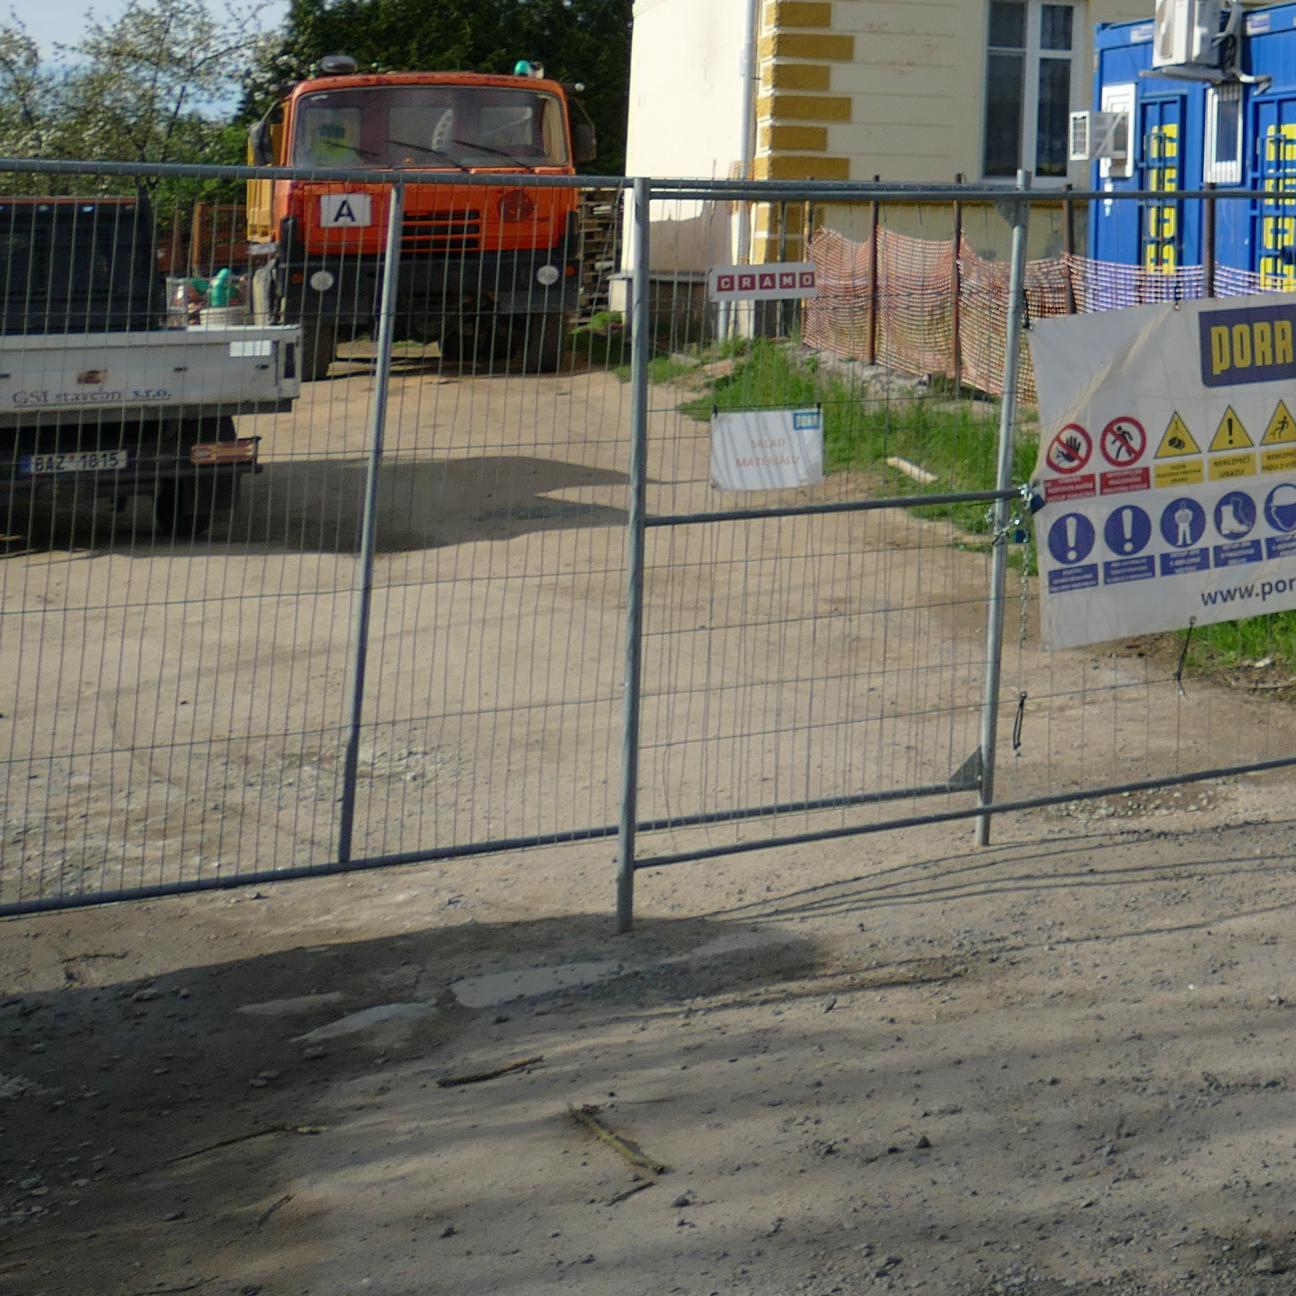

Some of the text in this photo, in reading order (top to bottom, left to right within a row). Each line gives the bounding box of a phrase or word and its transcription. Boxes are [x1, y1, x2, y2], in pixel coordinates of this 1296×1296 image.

[333, 199, 357, 222] A
[719, 273, 814, 291] CRAMO
[1210, 319, 1295, 376] PORR
